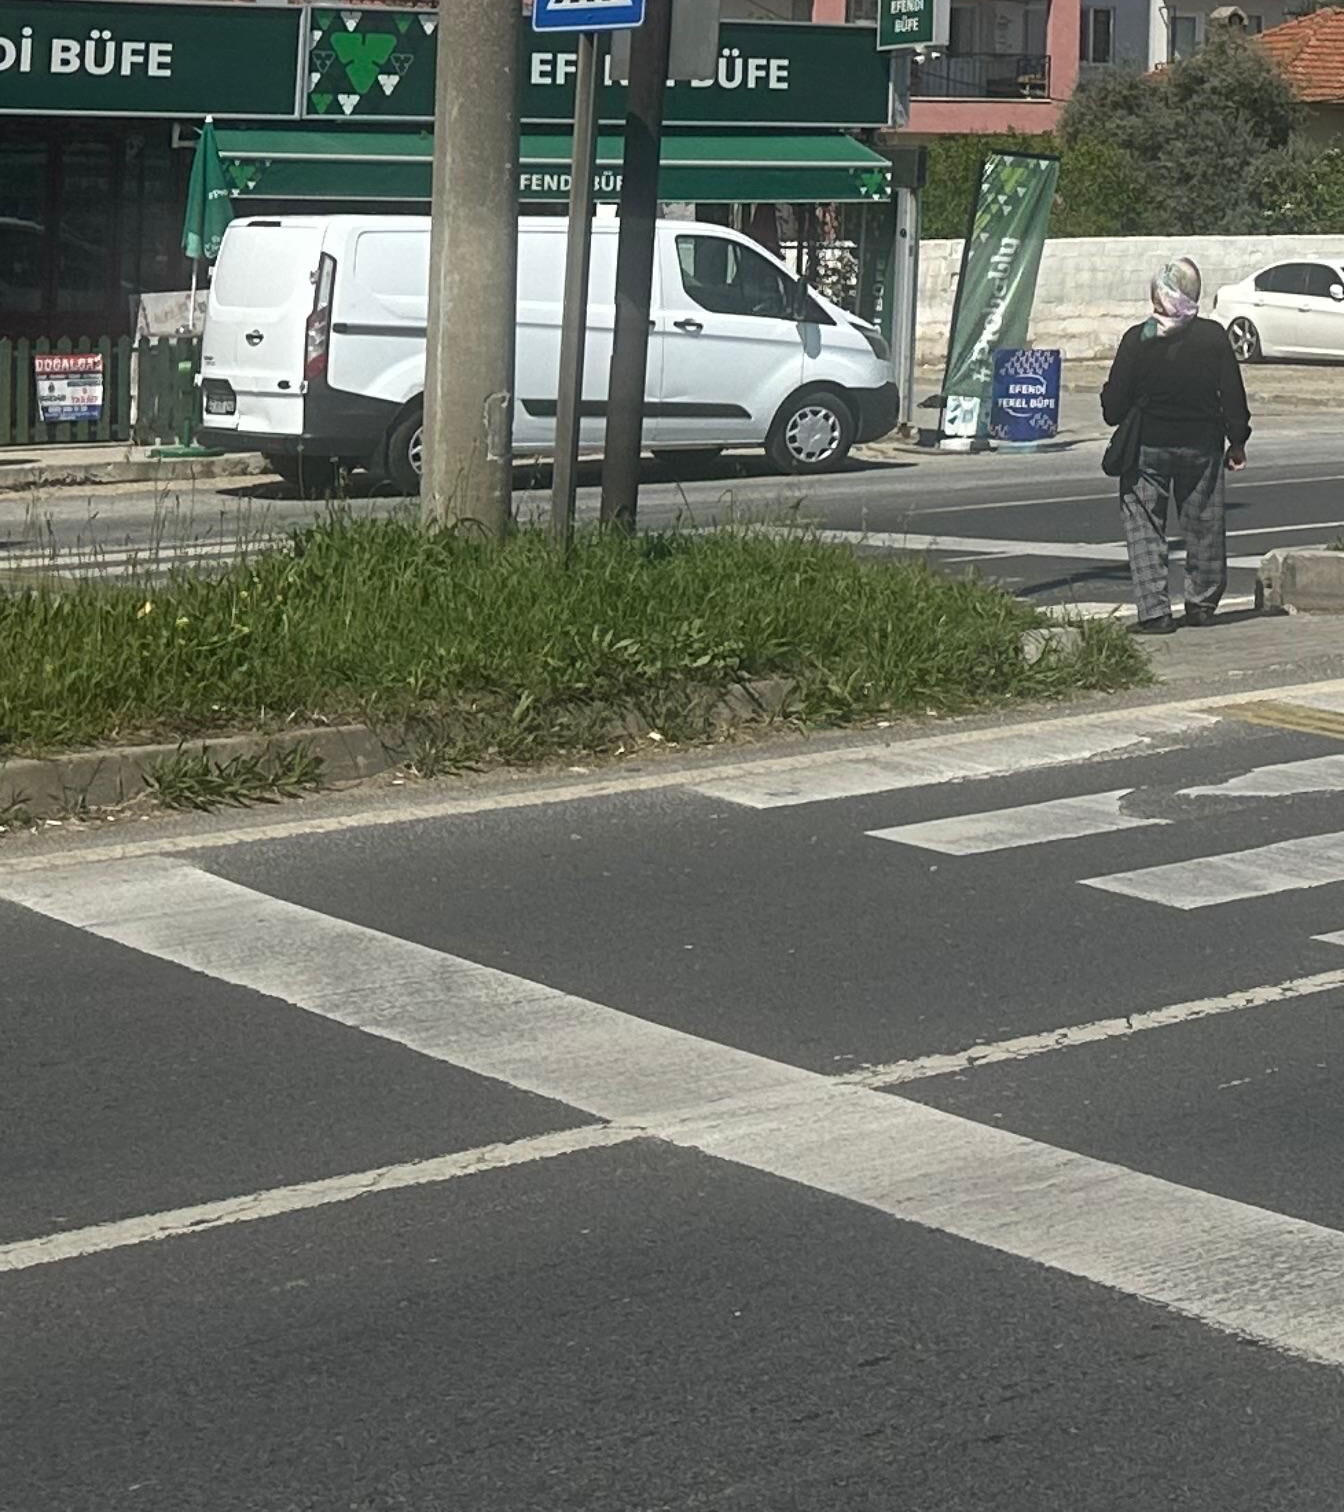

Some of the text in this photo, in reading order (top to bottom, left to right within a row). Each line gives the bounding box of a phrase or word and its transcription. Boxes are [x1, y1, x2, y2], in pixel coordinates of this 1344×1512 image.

[50, 29, 173, 77] BÜFE
[691, 48, 790, 90] ÜFE
[519, 173, 573, 191] FEND
